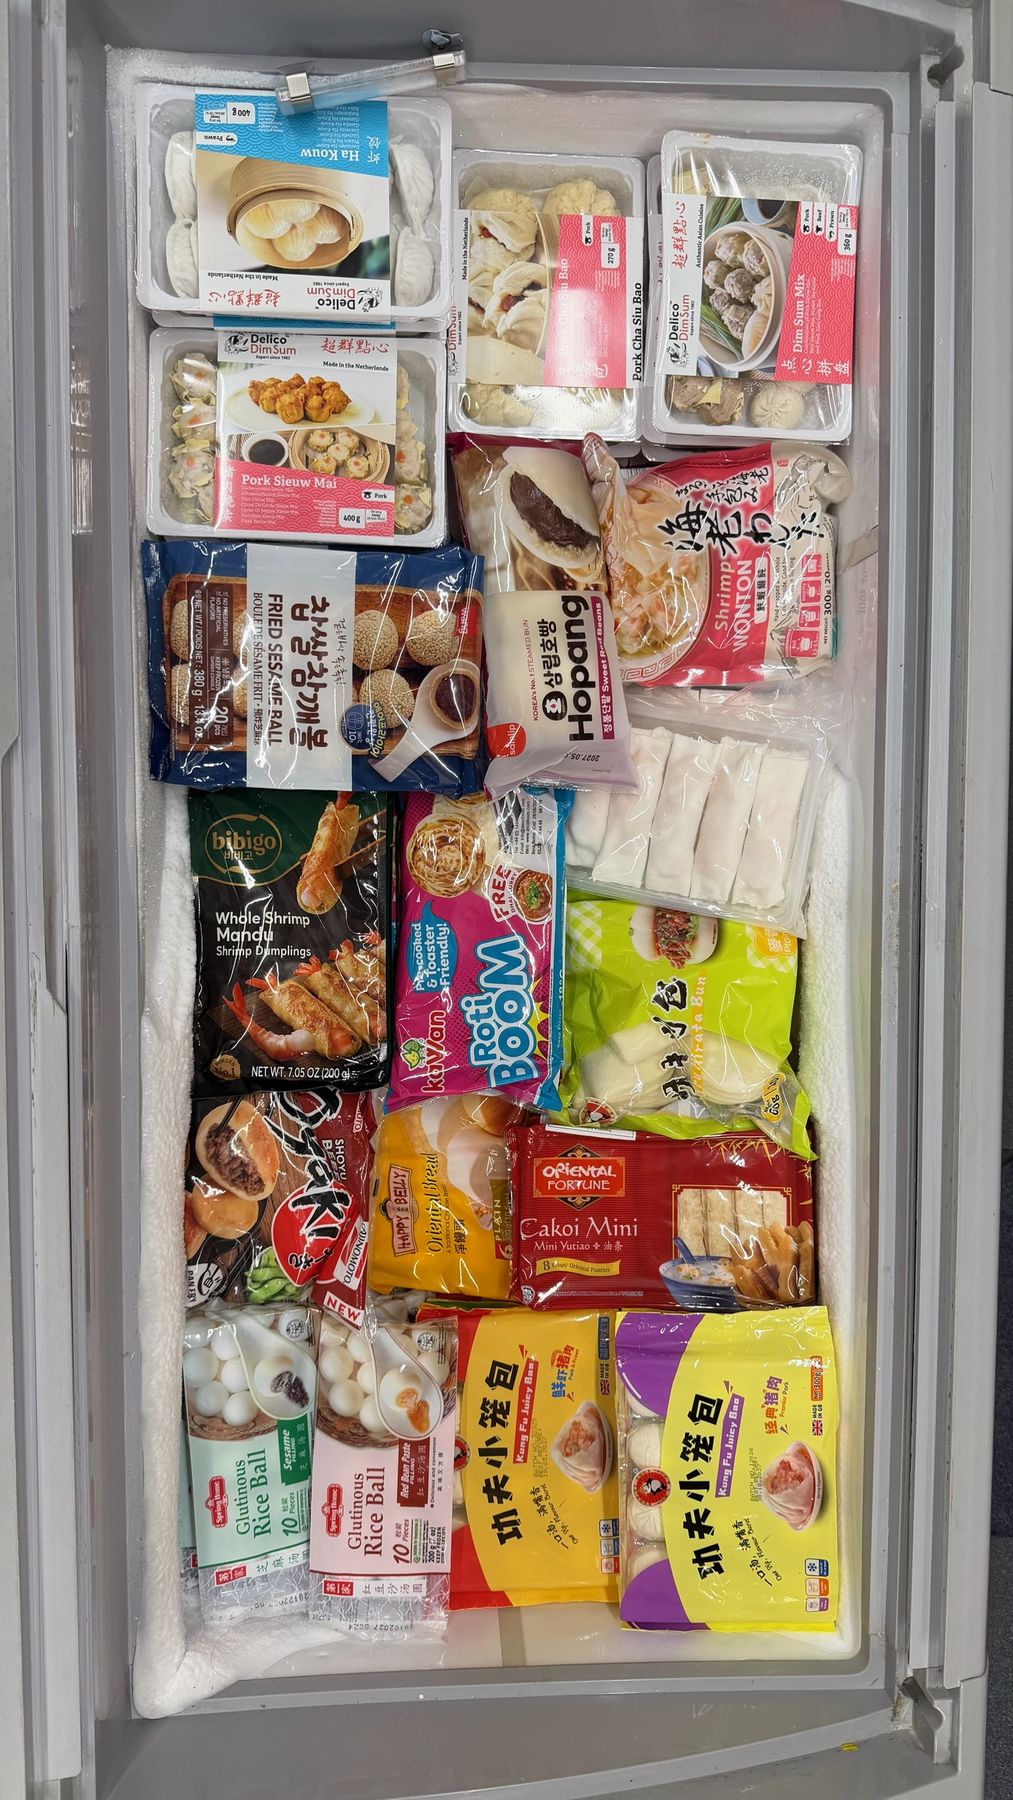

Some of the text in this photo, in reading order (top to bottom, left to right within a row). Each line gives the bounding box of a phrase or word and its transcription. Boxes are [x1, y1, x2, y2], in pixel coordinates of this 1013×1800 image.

[238, 109, 251, 117] 400
[301, 149, 359, 161] Ha Kouw
[559, 258, 569, 279] Bao
[606, 252, 614, 264] 270
[695, 240, 703, 269] Authentic
[207, 272, 244, 280] Netherlands
[317, 298, 356, 310] Delico
[669, 303, 680, 341] Delico
[792, 273, 805, 354] Dim Sum Mix
[250, 334, 287, 344] Delico
[632, 283, 642, 381] Pork Cha Siu Bao
[355, 363, 389, 371] Netherlands
[241, 474, 338, 489] Pork Sieuw Mai
[705, 486, 759, 505] 手包み
[343, 514, 355, 522] 400
[714, 560, 736, 632] Shrimp
[732, 559, 753, 653] WONTON
[823, 589, 833, 616] 300g
[194, 599, 205, 687] NET POIDS 380
[536, 618, 563, 689] 삼립호빵
[595, 602, 610, 693] Sweet Red Beans
[252, 641, 266, 703] SÉSAME FRIT
[267, 593, 283, 747] FRIED SESAME BALL
[289, 594, 330, 751] 찹쌀참깨볼
[521, 619, 540, 721] KOREA's STEAMED BUN
[561, 594, 597, 742] Hopang
[213, 705, 229, 724] 20
[507, 723, 518, 756] samlip
[212, 831, 277, 856] bibigo
[224, 850, 254, 862] 비비고
[491, 865, 513, 920] FREE
[508, 894, 517, 914] DHAL
[215, 910, 311, 929] Whole Shrimp
[216, 926, 274, 942] Mandu
[216, 944, 312, 959] Shrimp Dumplings
[436, 922, 450, 987] Friendly!
[476, 933, 539, 1087] BOOM
[690, 976, 707, 1007] Bun
[460, 993, 498, 1066] Roti
[251, 1066, 320, 1079] NET WT. 7.05 OZ
[421, 1009, 446, 1094] kawan
[335, 1138, 347, 1181] SHOYU
[542, 1162, 617, 1178] ORIENTAL
[419, 1152, 444, 1253] Oriental Bread
[547, 1178, 611, 1191] FORTUNE
[393, 1170, 411, 1250] HAPPY BELLY
[493, 1199, 503, 1241] PLAIN
[519, 1216, 639, 1238] Cakoi Mini
[342, 1223, 370, 1285] AJINOMOTO
[499, 1243, 513, 1259] 6
[533, 1241, 591, 1252] Mini Yutiao
[543, 1260, 551, 1271] 8
[552, 1261, 568, 1269] Crispy
[569, 1262, 590, 1272] Oriental
[603, 1241, 624, 1252] 油条
[326, 1298, 361, 1323] NEW
[551, 1344, 575, 1398] 鲜虾猪肉
[514, 1362, 537, 1463] Kung Fu Juicy Bao
[763, 1376, 783, 1435] 经典猪肉
[281, 1429, 293, 1471] Sesame
[478, 1359, 523, 1546] 功夫小笼包
[717, 1397, 741, 1497] Kung Fu Juicy Bao
[400, 1442, 411, 1499] Red Bean Paste
[678, 1393, 725, 1580] 功夫小笼包
[212, 1481, 225, 1524] Spring Home
[233, 1459, 251, 1536] Glutinous
[247, 1448, 272, 1539] Rice Ball
[289, 1491, 297, 1514] Pieces
[329, 1488, 338, 1532] Spring Home
[347, 1472, 364, 1551] Glutinous
[363, 1466, 386, 1557] Rice Ball
[280, 1517, 299, 1537] 10
[392, 1518, 411, 1564] 10 Pieces
[428, 1551, 436, 1564] 200
